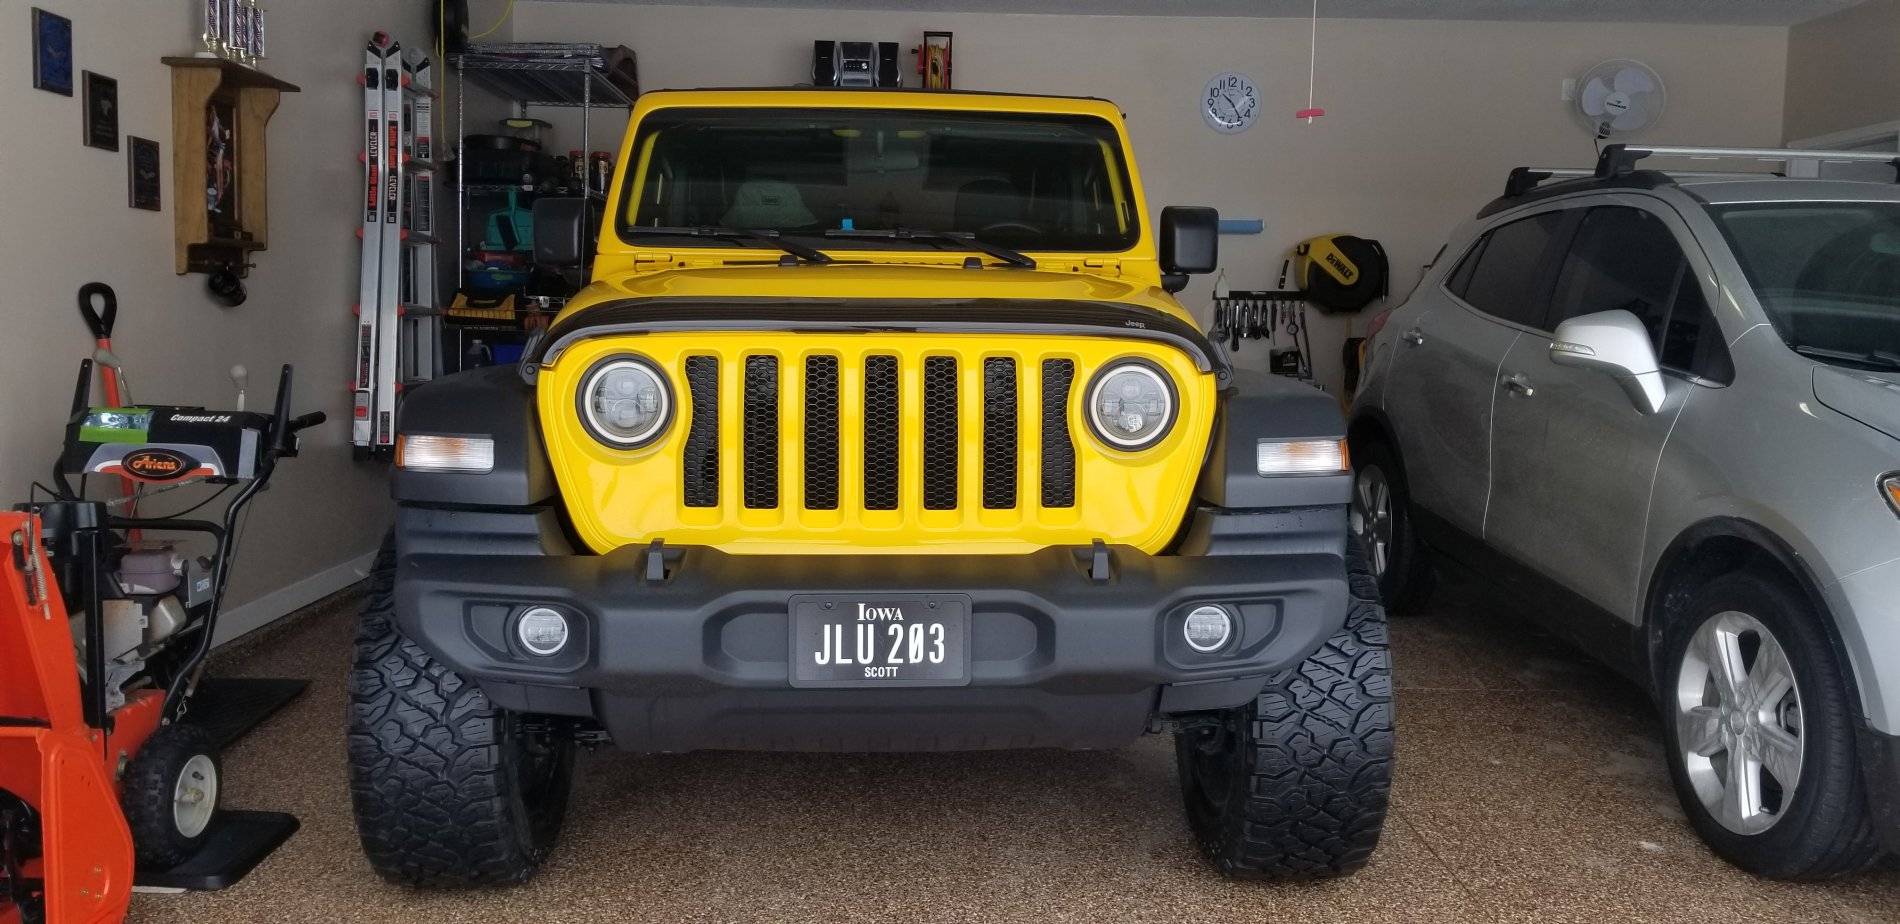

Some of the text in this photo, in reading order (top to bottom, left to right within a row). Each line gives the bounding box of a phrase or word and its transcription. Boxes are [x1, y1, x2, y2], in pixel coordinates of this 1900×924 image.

[1219, 80, 1225, 90] 11
[1228, 77, 1237, 88] 12
[1210, 87, 1219, 98] 10
[1245, 86, 1252, 97] 2
[1207, 98, 1214, 108] 9
[1249, 98, 1255, 108] 3
[1244, 108, 1250, 118] 4
[1227, 118, 1233, 129] 6
[1236, 116, 1243, 127] 5
[369, 131, 378, 158] LEVELER
[388, 175, 397, 201] LEVELER
[1125, 319, 1147, 329] Jeep
[170, 414, 231, 423] Compact 24
[132, 455, 176, 470] Ariens
[814, 623, 945, 665] JLU 203
[864, 666, 899, 678] SCOTT
